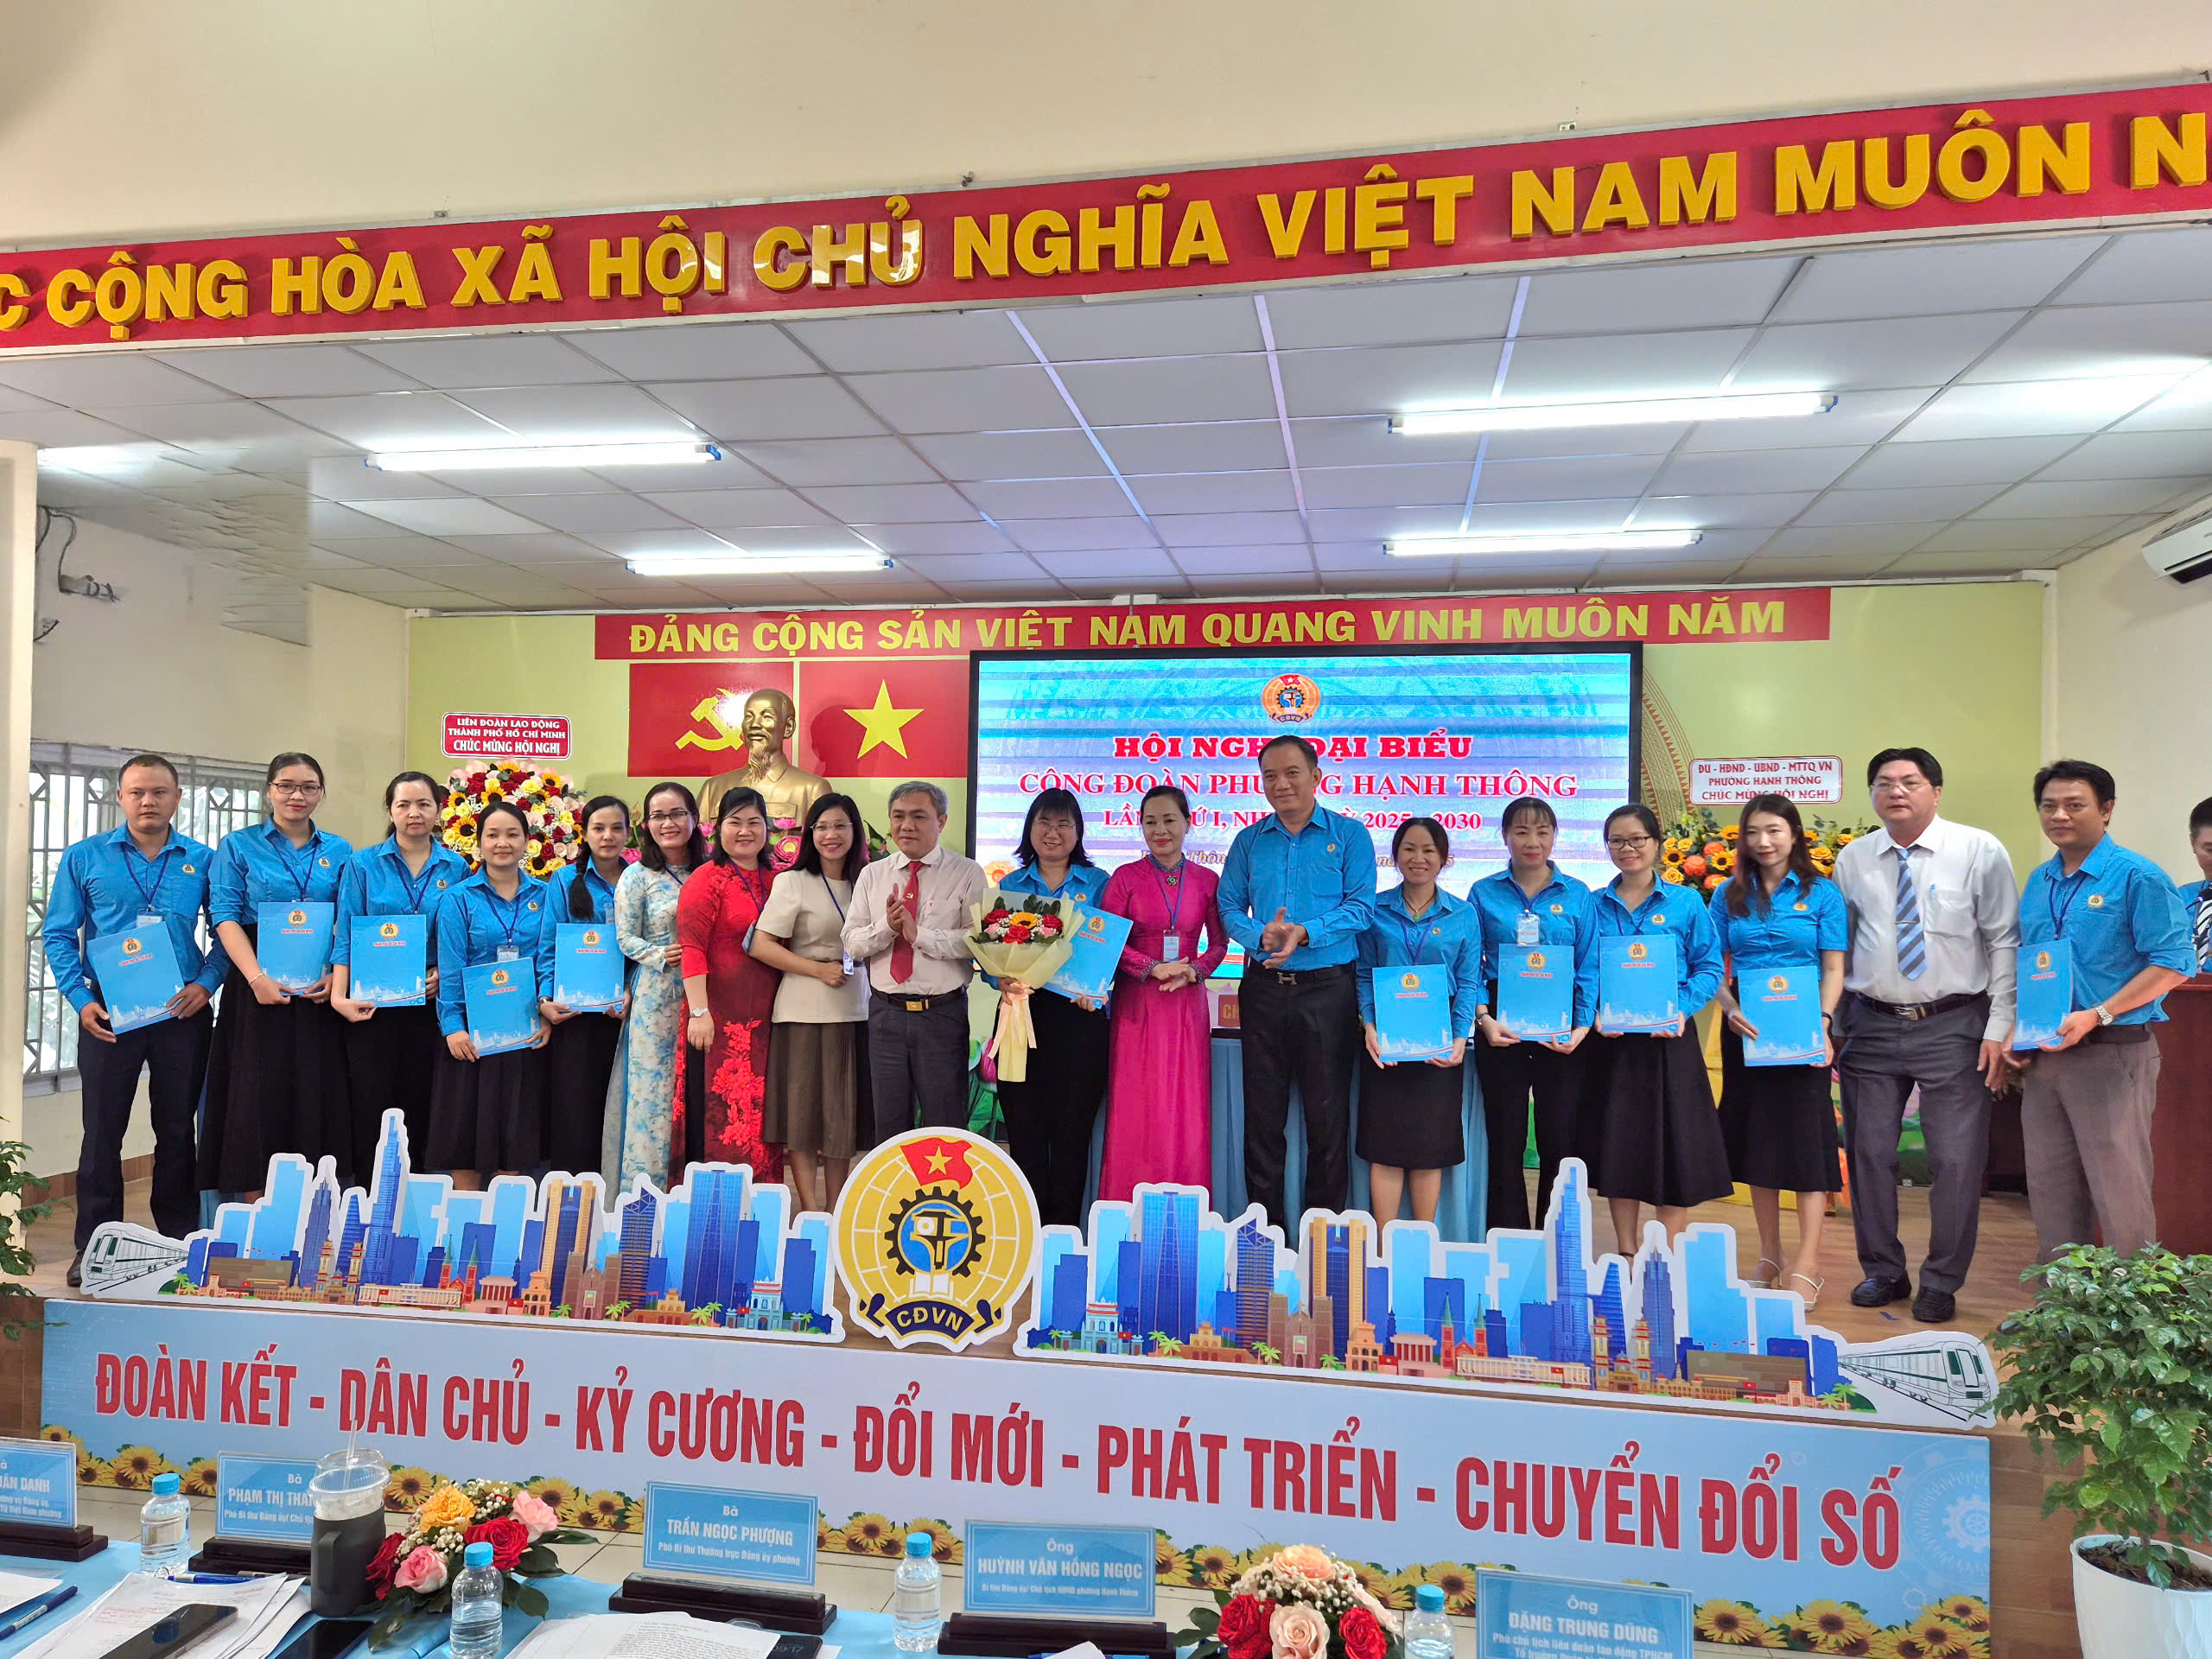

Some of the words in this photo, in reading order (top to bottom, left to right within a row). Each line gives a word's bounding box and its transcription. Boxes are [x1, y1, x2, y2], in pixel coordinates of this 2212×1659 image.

[46, 251, 248, 340] CỘNG
[271, 237, 427, 315] HÒA
[450, 224, 561, 307] XÃ
[588, 215, 726, 315] HỘI
[753, 194, 924, 289] CHỦ
[953, 182, 1229, 280] NGHĨA
[1257, 163, 1474, 269] VIỆT
[1510, 151, 1737, 239] NAM
[1773, 109, 2090, 216] MUÔN
[629, 613, 740, 652] ĐẢNG
[752, 613, 864, 656] CỘNG
[877, 610, 963, 649] SẢN
[976, 610, 1072, 649] VIỆT
[1090, 613, 1186, 646] NAM
[1203, 611, 1356, 648] QUANG
[1371, 608, 1482, 640] VINH
[1503, 596, 1649, 639] MUÔN
[1669, 596, 1785, 637] NĂM
[457, 717, 477, 727] LIÊN
[531, 720, 559, 729] ĐỘNG
[448, 728, 480, 736] THÀNH
[484, 728, 503, 737] PHỐ
[523, 729, 537, 738] CHÍ
[454, 738, 480, 752] CHÚC
[515, 740, 532, 754] HỘI
[536, 742, 560, 755] NGHỊ
[1114, 733, 1182, 762] HỘI
[1192, 737, 1274, 758] NGH
[1379, 728, 1472, 759] BIỂU
[1719, 764, 1745, 772] HĐND
[1755, 763, 1779, 772] UBND
[1789, 762, 1816, 772] MTTQ
[1819, 761, 1832, 771] VN
[1020, 769, 1105, 794] CÔNG
[1113, 769, 1200, 794] ĐOÀN
[1353, 775, 1446, 801] HẠNH
[1458, 770, 1577, 797] THÔNG
[1754, 776, 1781, 786] HẠNH
[1785, 775, 1821, 785] THÔNG
[1702, 789, 1732, 799] CHÚC
[1433, 813, 1481, 830] 2030
[1187, 849, 1226, 863] Thôn
[897, 1307, 963, 1332] CĐVN
[95, 1344, 207, 1421] ĐOÀN
[220, 1343, 297, 1427] KẾT
[309, 1395, 324, 1408] -
[340, 1357, 429, 1438] DÂN
[442, 1358, 530, 1446] CHỦ
[544, 1414, 561, 1427] -
[576, 1365, 633, 1453] KỶ
[648, 1388, 804, 1467] CƯƠNG
[821, 1434, 837, 1448] -
[853, 1381, 932, 1478] ĐỔI
[951, 1402, 1043, 1487] MỚI
[1062, 1454, 1078, 1468] -
[1097, 1415, 1228, 1504] PHÁT
[1243, 1416, 1396, 1522] TRIỂN
[1417, 1487, 1435, 1502] -
[1456, 1440, 1679, 1549] CHUYỂN
[1699, 1452, 1797, 1561] ĐỔI
[1821, 1466, 1903, 1570] SỐ
[21, 1478, 50, 1494] DANH
[288, 1473, 302, 1484] Bà
[228, 1488, 263, 1507] PHẠM
[266, 1491, 283, 1507] THỊ
[723, 1505, 738, 1516] Bà
[667, 1516, 700, 1536] TRẦN
[703, 1522, 738, 1543] NGỌC
[741, 1527, 793, 1548] PHƯỢNG
[658, 1541, 672, 1552] Phó
[1046, 1538, 1074, 1555] Ông
[978, 1555, 1025, 1575] HUỲNH
[1029, 1556, 1057, 1576] VĂN
[1103, 1562, 1142, 1581] NGỌC
[1567, 1595, 1598, 1614] Ông
[1509, 1611, 1552, 1633] ĐẶNG
[1557, 1618, 1609, 1638] TRUNG
[1614, 1621, 1659, 1643] DŨNG
